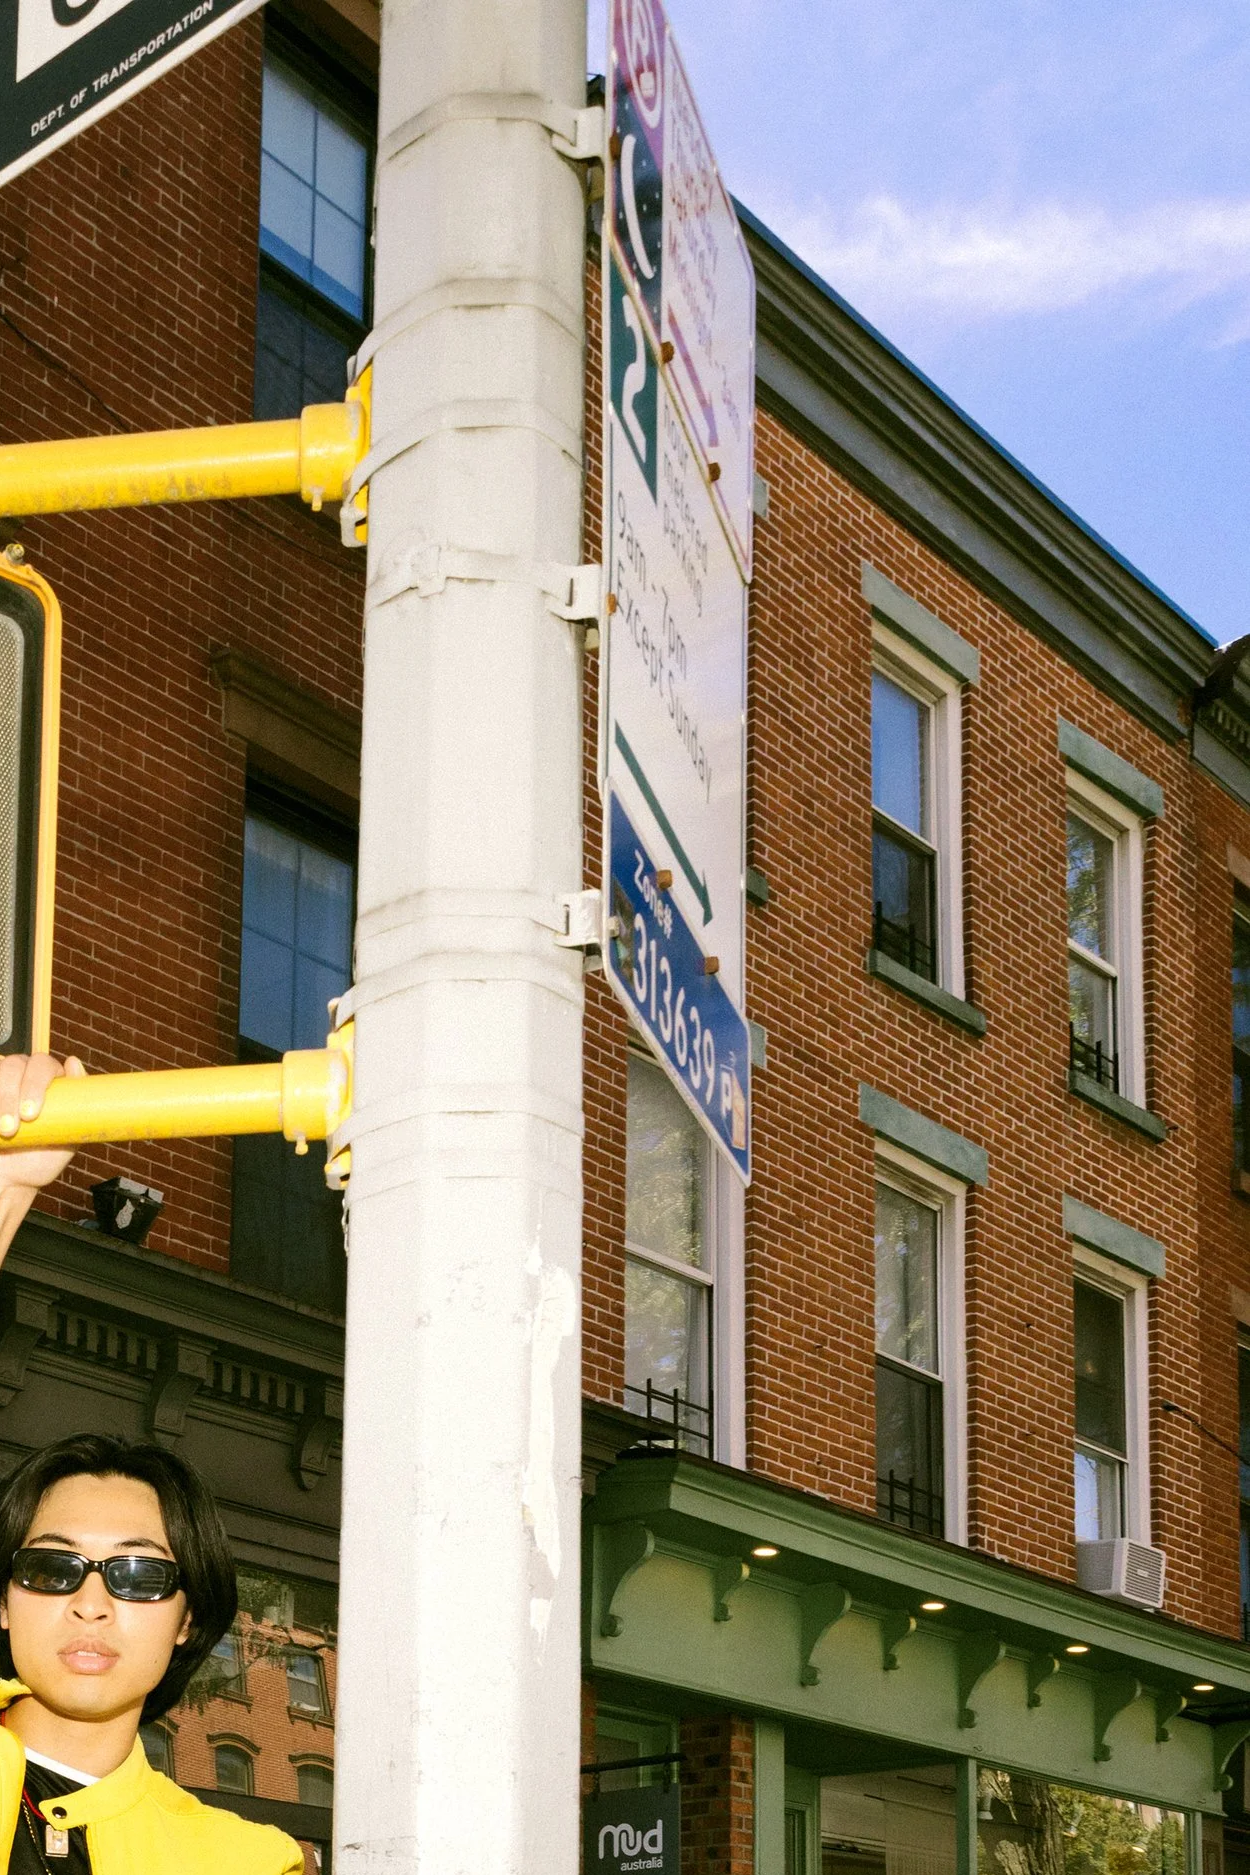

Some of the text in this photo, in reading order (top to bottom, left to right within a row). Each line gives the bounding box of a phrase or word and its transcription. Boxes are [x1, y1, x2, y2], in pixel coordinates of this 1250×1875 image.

[30, 107, 65, 137] DEPT.
[69, 88, 89, 110] OF
[92, 0, 214, 93] TRANSPORTATION
[663, 390, 689, 473] hour
[663, 451, 708, 578] metered
[663, 499, 703, 618] parking
[617, 490, 646, 592] 9am
[661, 584, 688, 681] 7pm
[616, 559, 713, 804] Except Sunday
[632, 912, 716, 1106] 313639
[620, 1857, 663, 1872] australia
